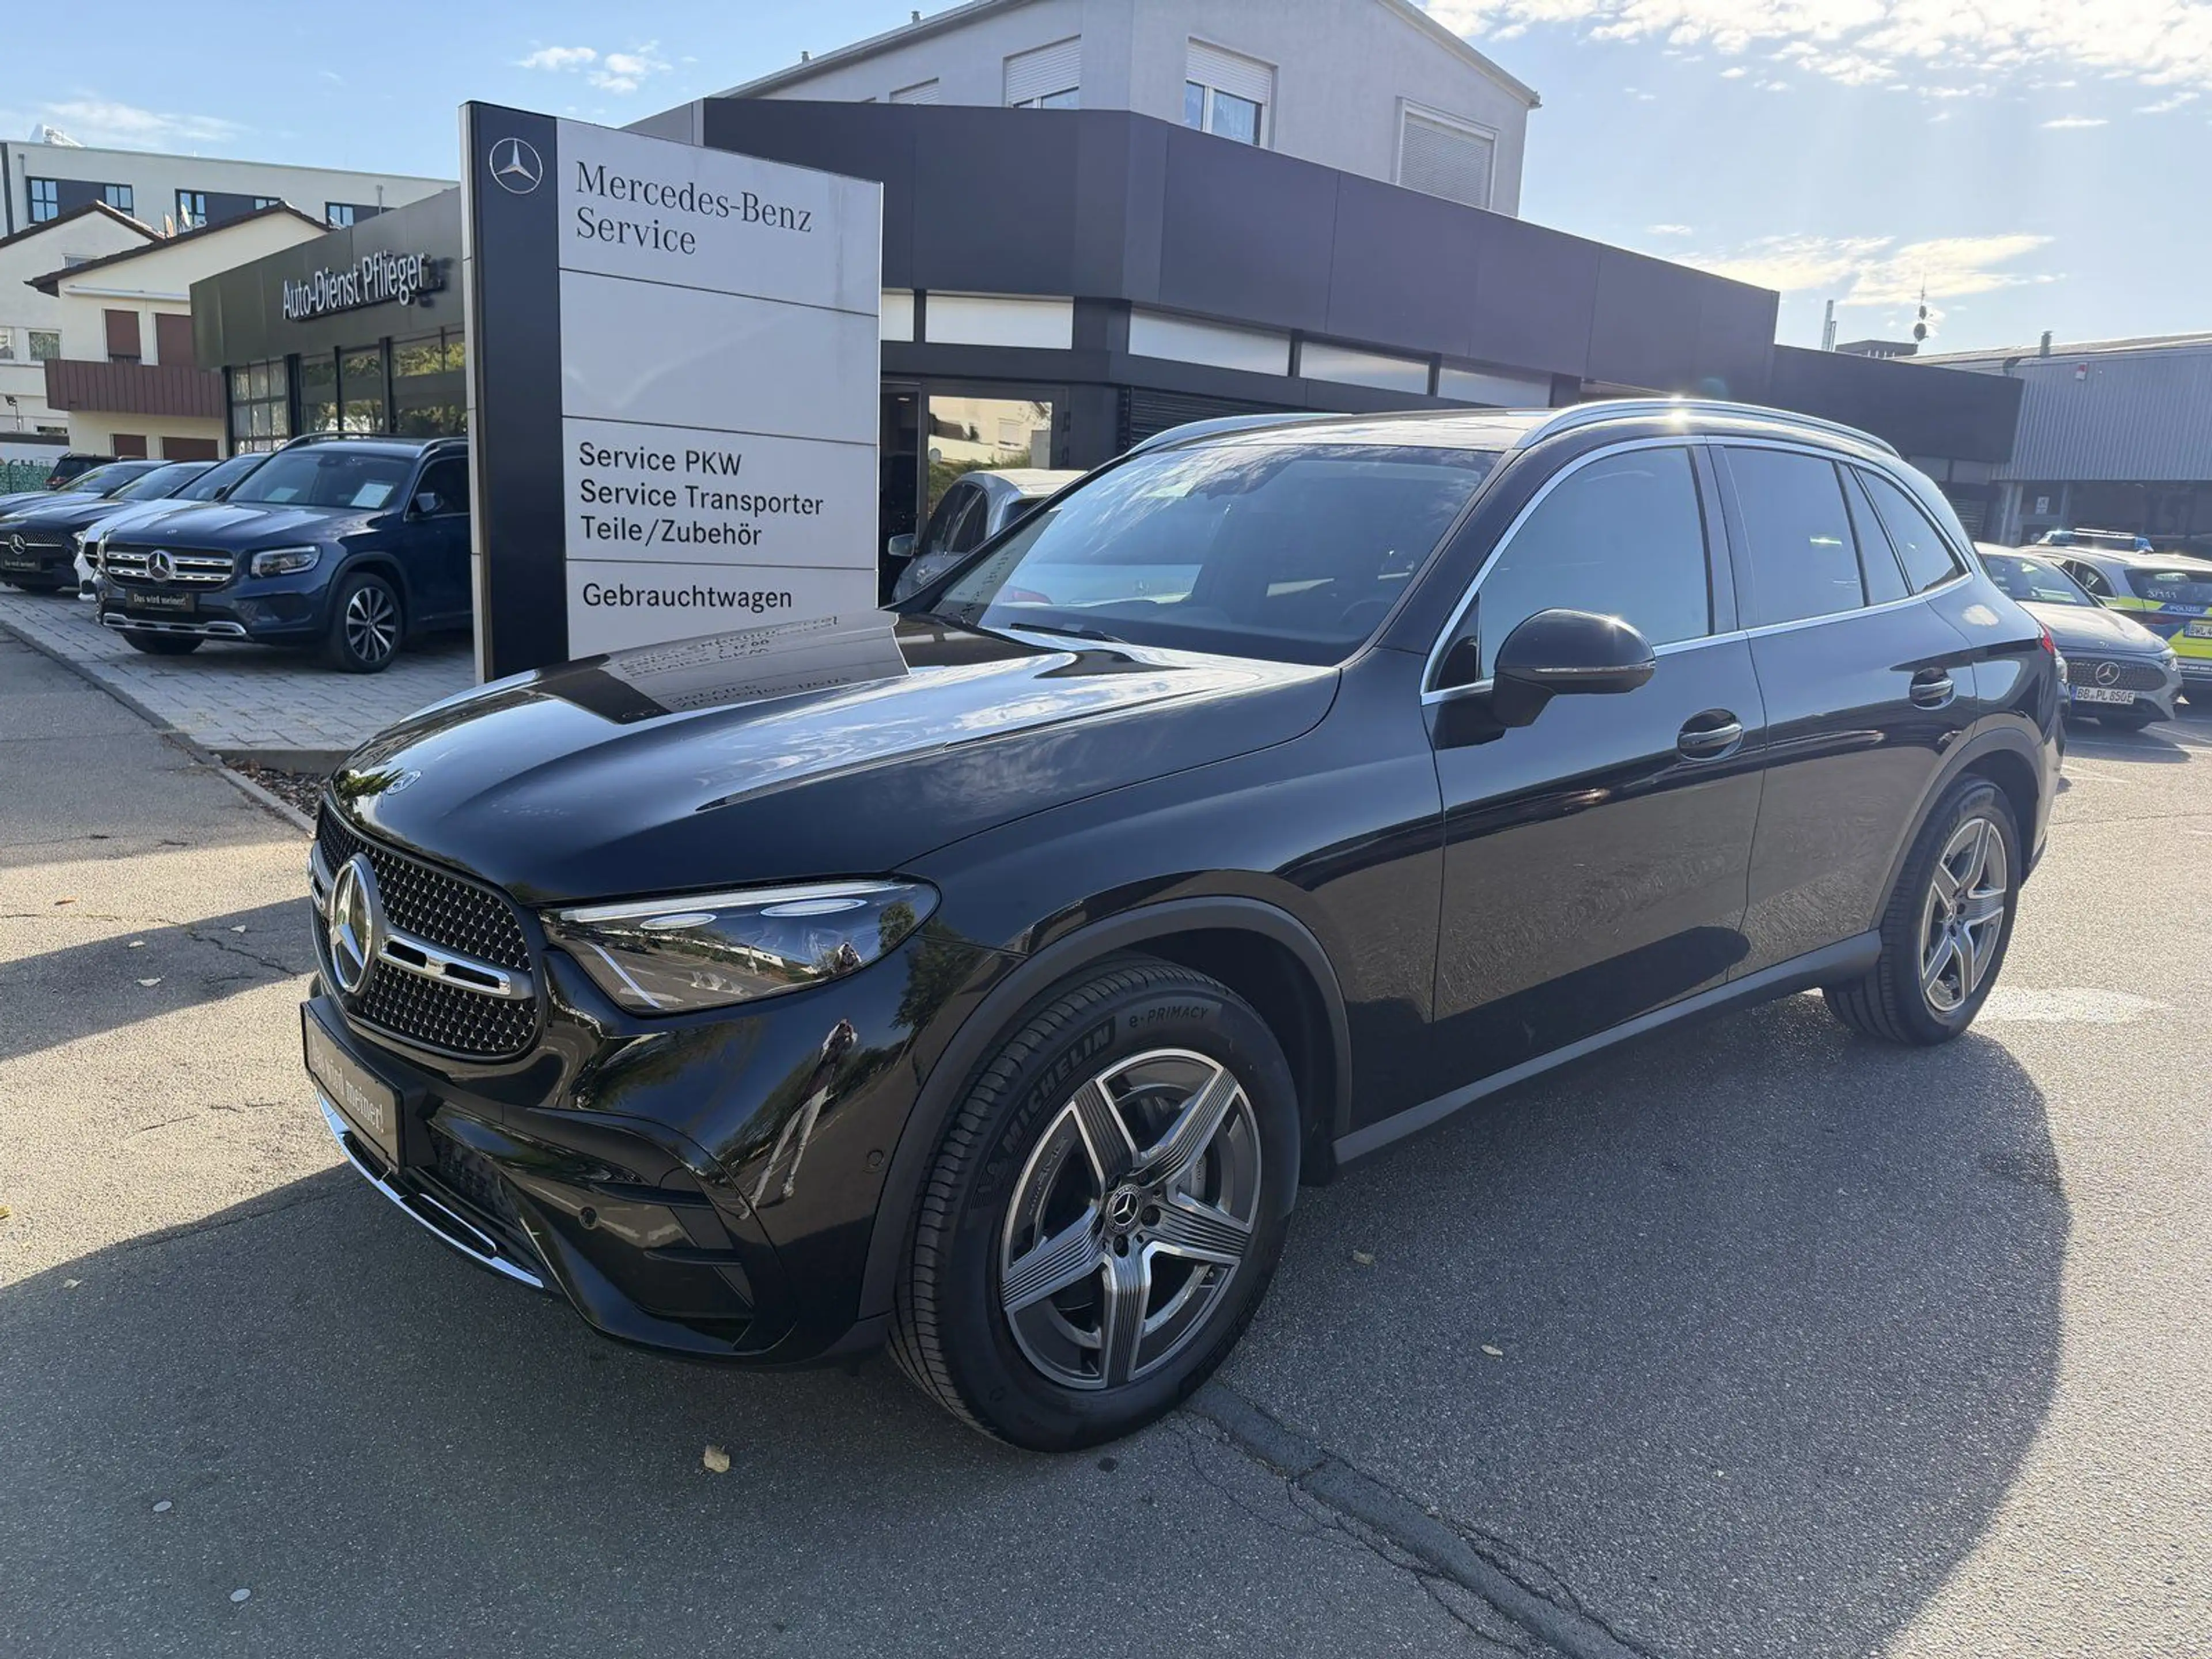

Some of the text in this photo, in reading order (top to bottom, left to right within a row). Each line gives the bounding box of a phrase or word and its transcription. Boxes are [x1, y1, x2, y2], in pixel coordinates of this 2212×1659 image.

[576, 161, 812, 232] Mercedes-Benz
[576, 207, 696, 255] Service
[283, 249, 425, 319] Auto-Dienst Pflieger
[579, 442, 741, 476] Service PKW
[579, 480, 824, 517] Service Transporter
[581, 516, 763, 546] Teile/Zubehör
[582, 583, 793, 613] Gebrauchtwagen
[2169, 605, 2200, 613] POLIZEI
[2096, 690, 2108, 701] PL
[344, 1078, 385, 1134] meiner!
[1000, 1024, 1112, 1153] MICHELIN
